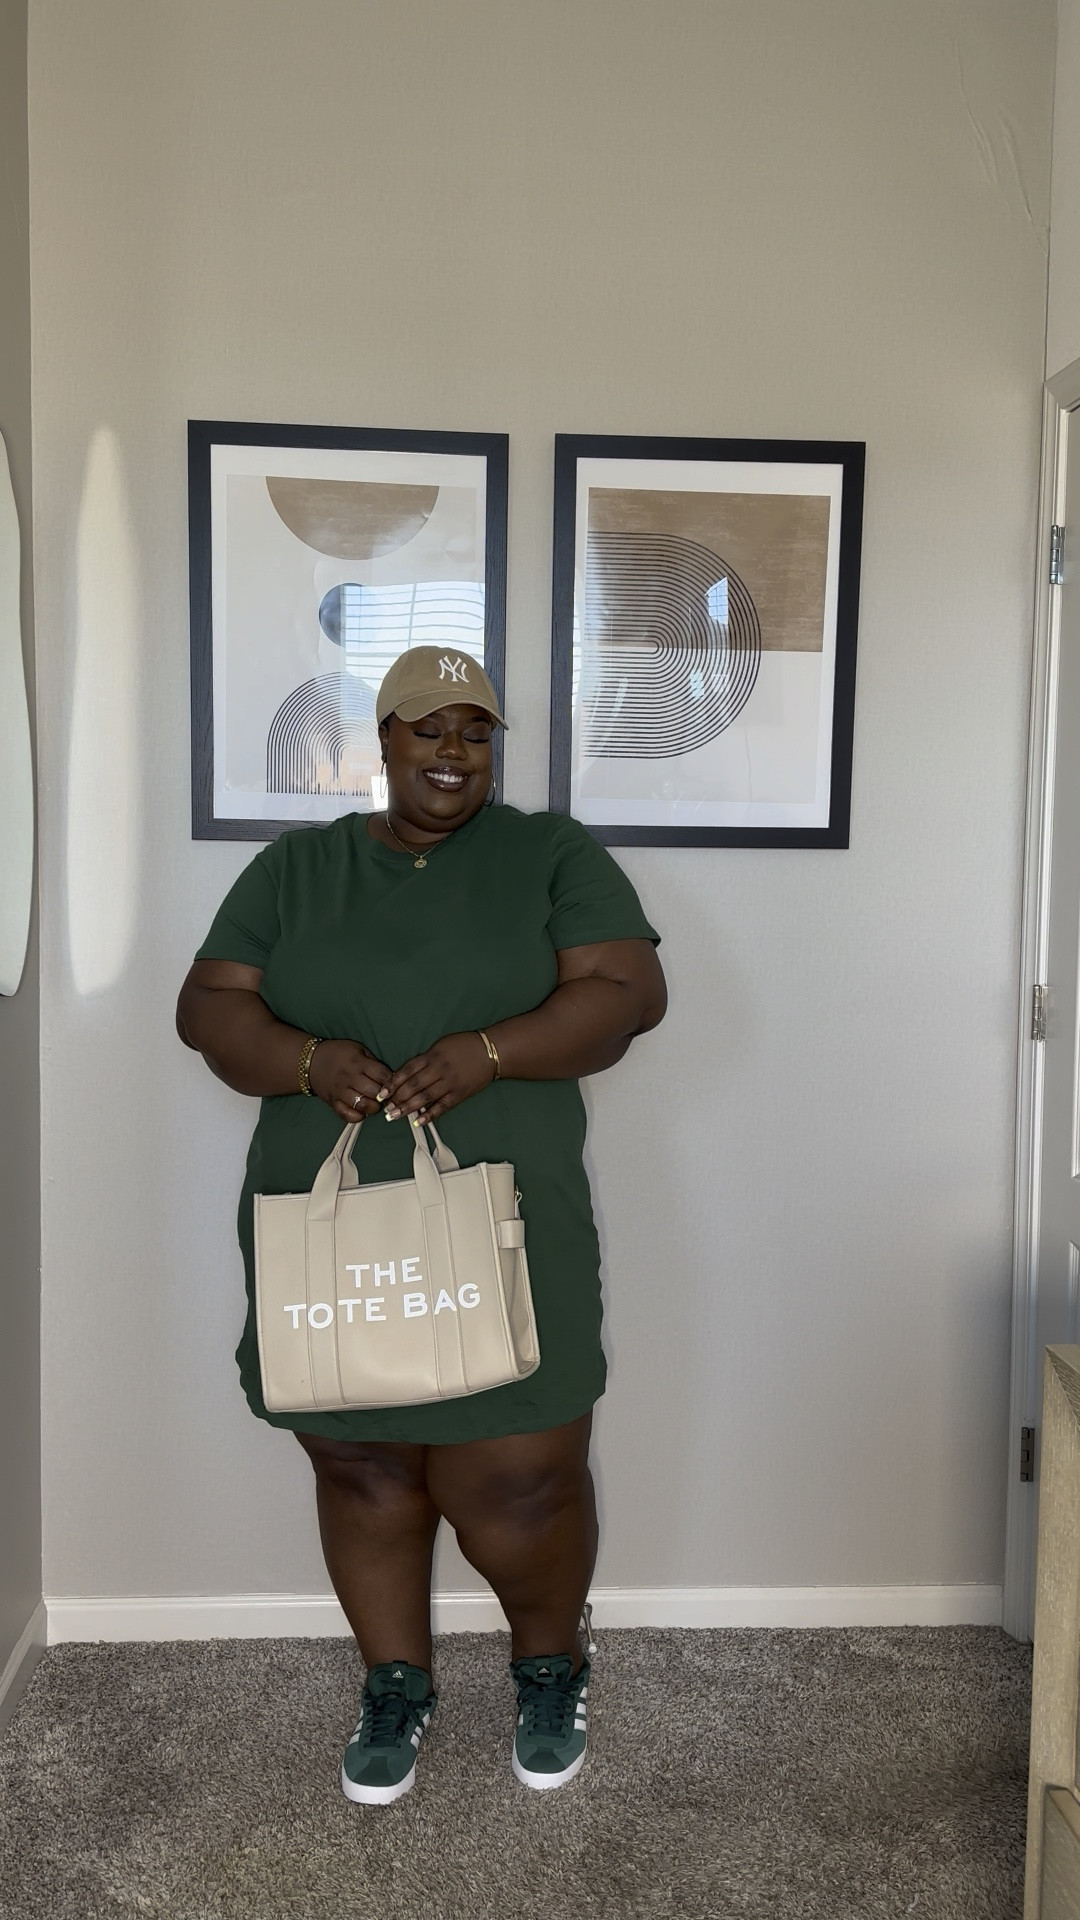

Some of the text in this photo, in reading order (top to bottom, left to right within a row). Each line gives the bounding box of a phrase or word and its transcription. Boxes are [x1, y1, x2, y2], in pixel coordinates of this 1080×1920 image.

[438, 655, 470, 683] NY
[345, 1256, 423, 1288] THE
[283, 1282, 481, 1329] TOTE BAG
